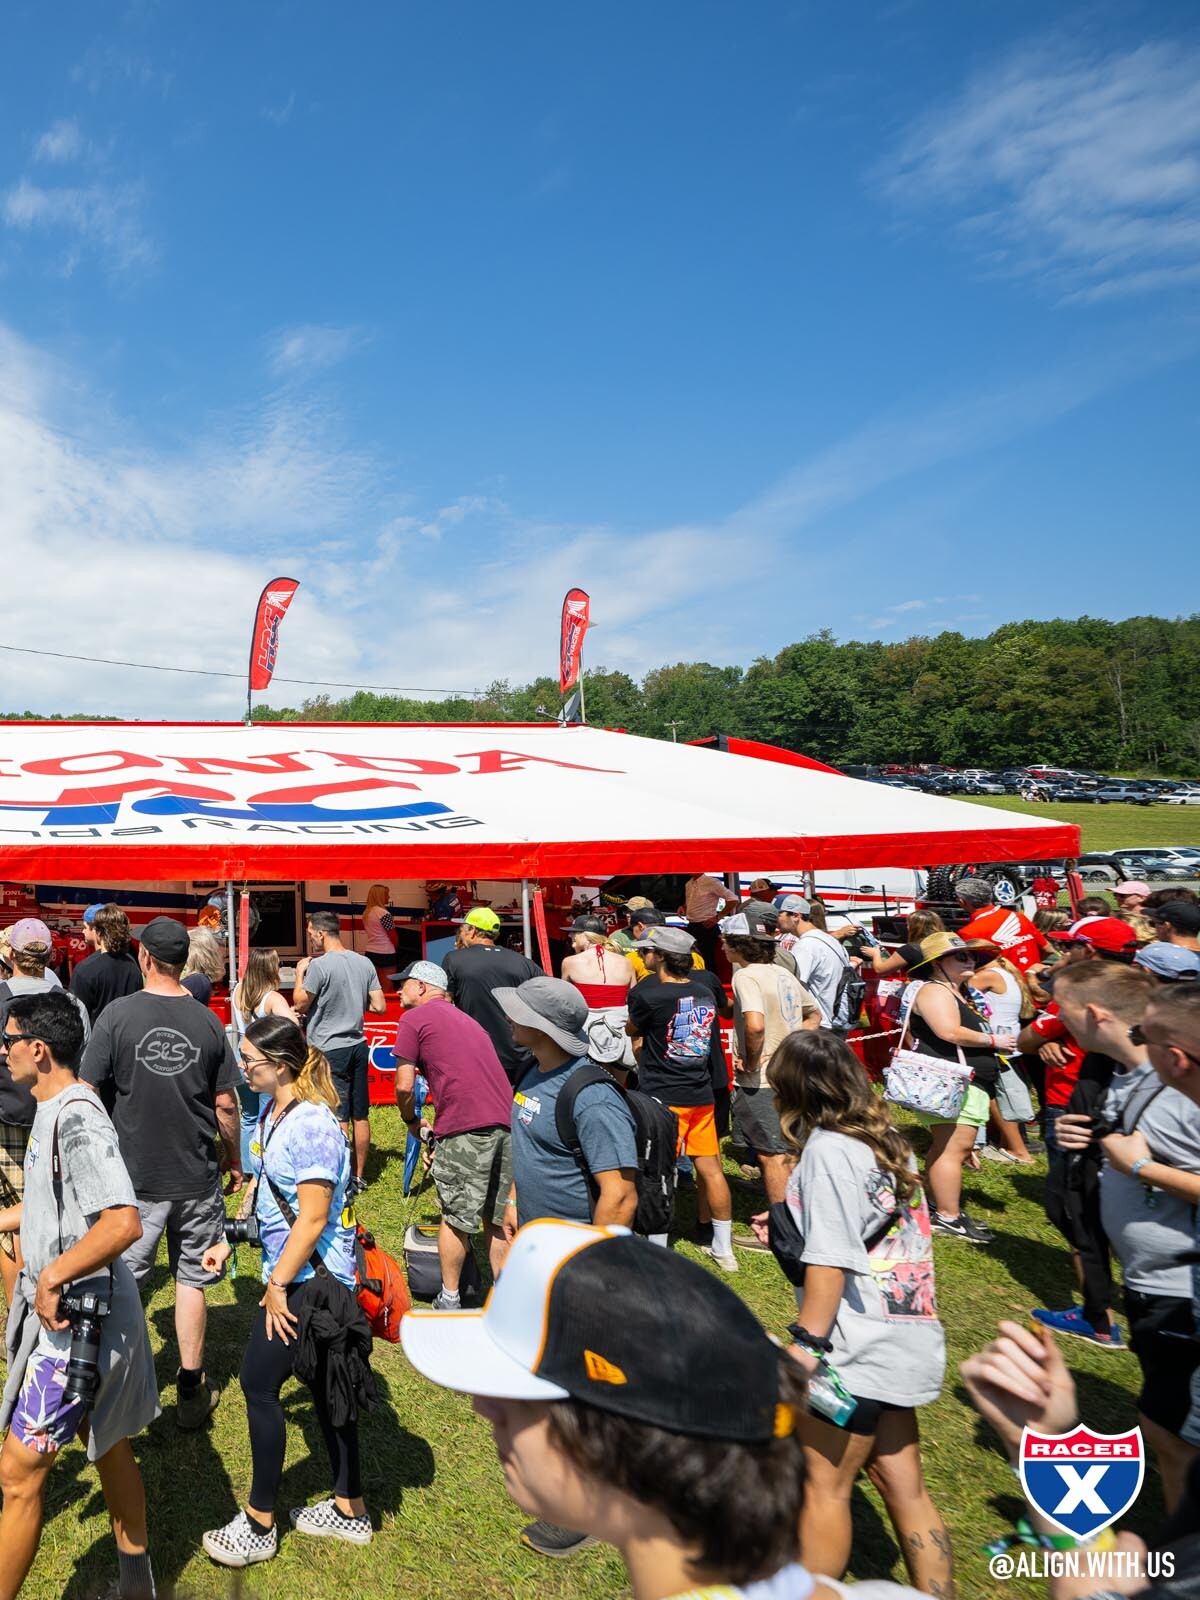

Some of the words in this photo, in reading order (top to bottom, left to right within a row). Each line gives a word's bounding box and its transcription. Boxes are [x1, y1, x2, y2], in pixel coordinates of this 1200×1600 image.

[181, 815, 486, 835] RACING
[70, 938, 87, 950] 96
[145, 1040, 188, 1061] S&S
